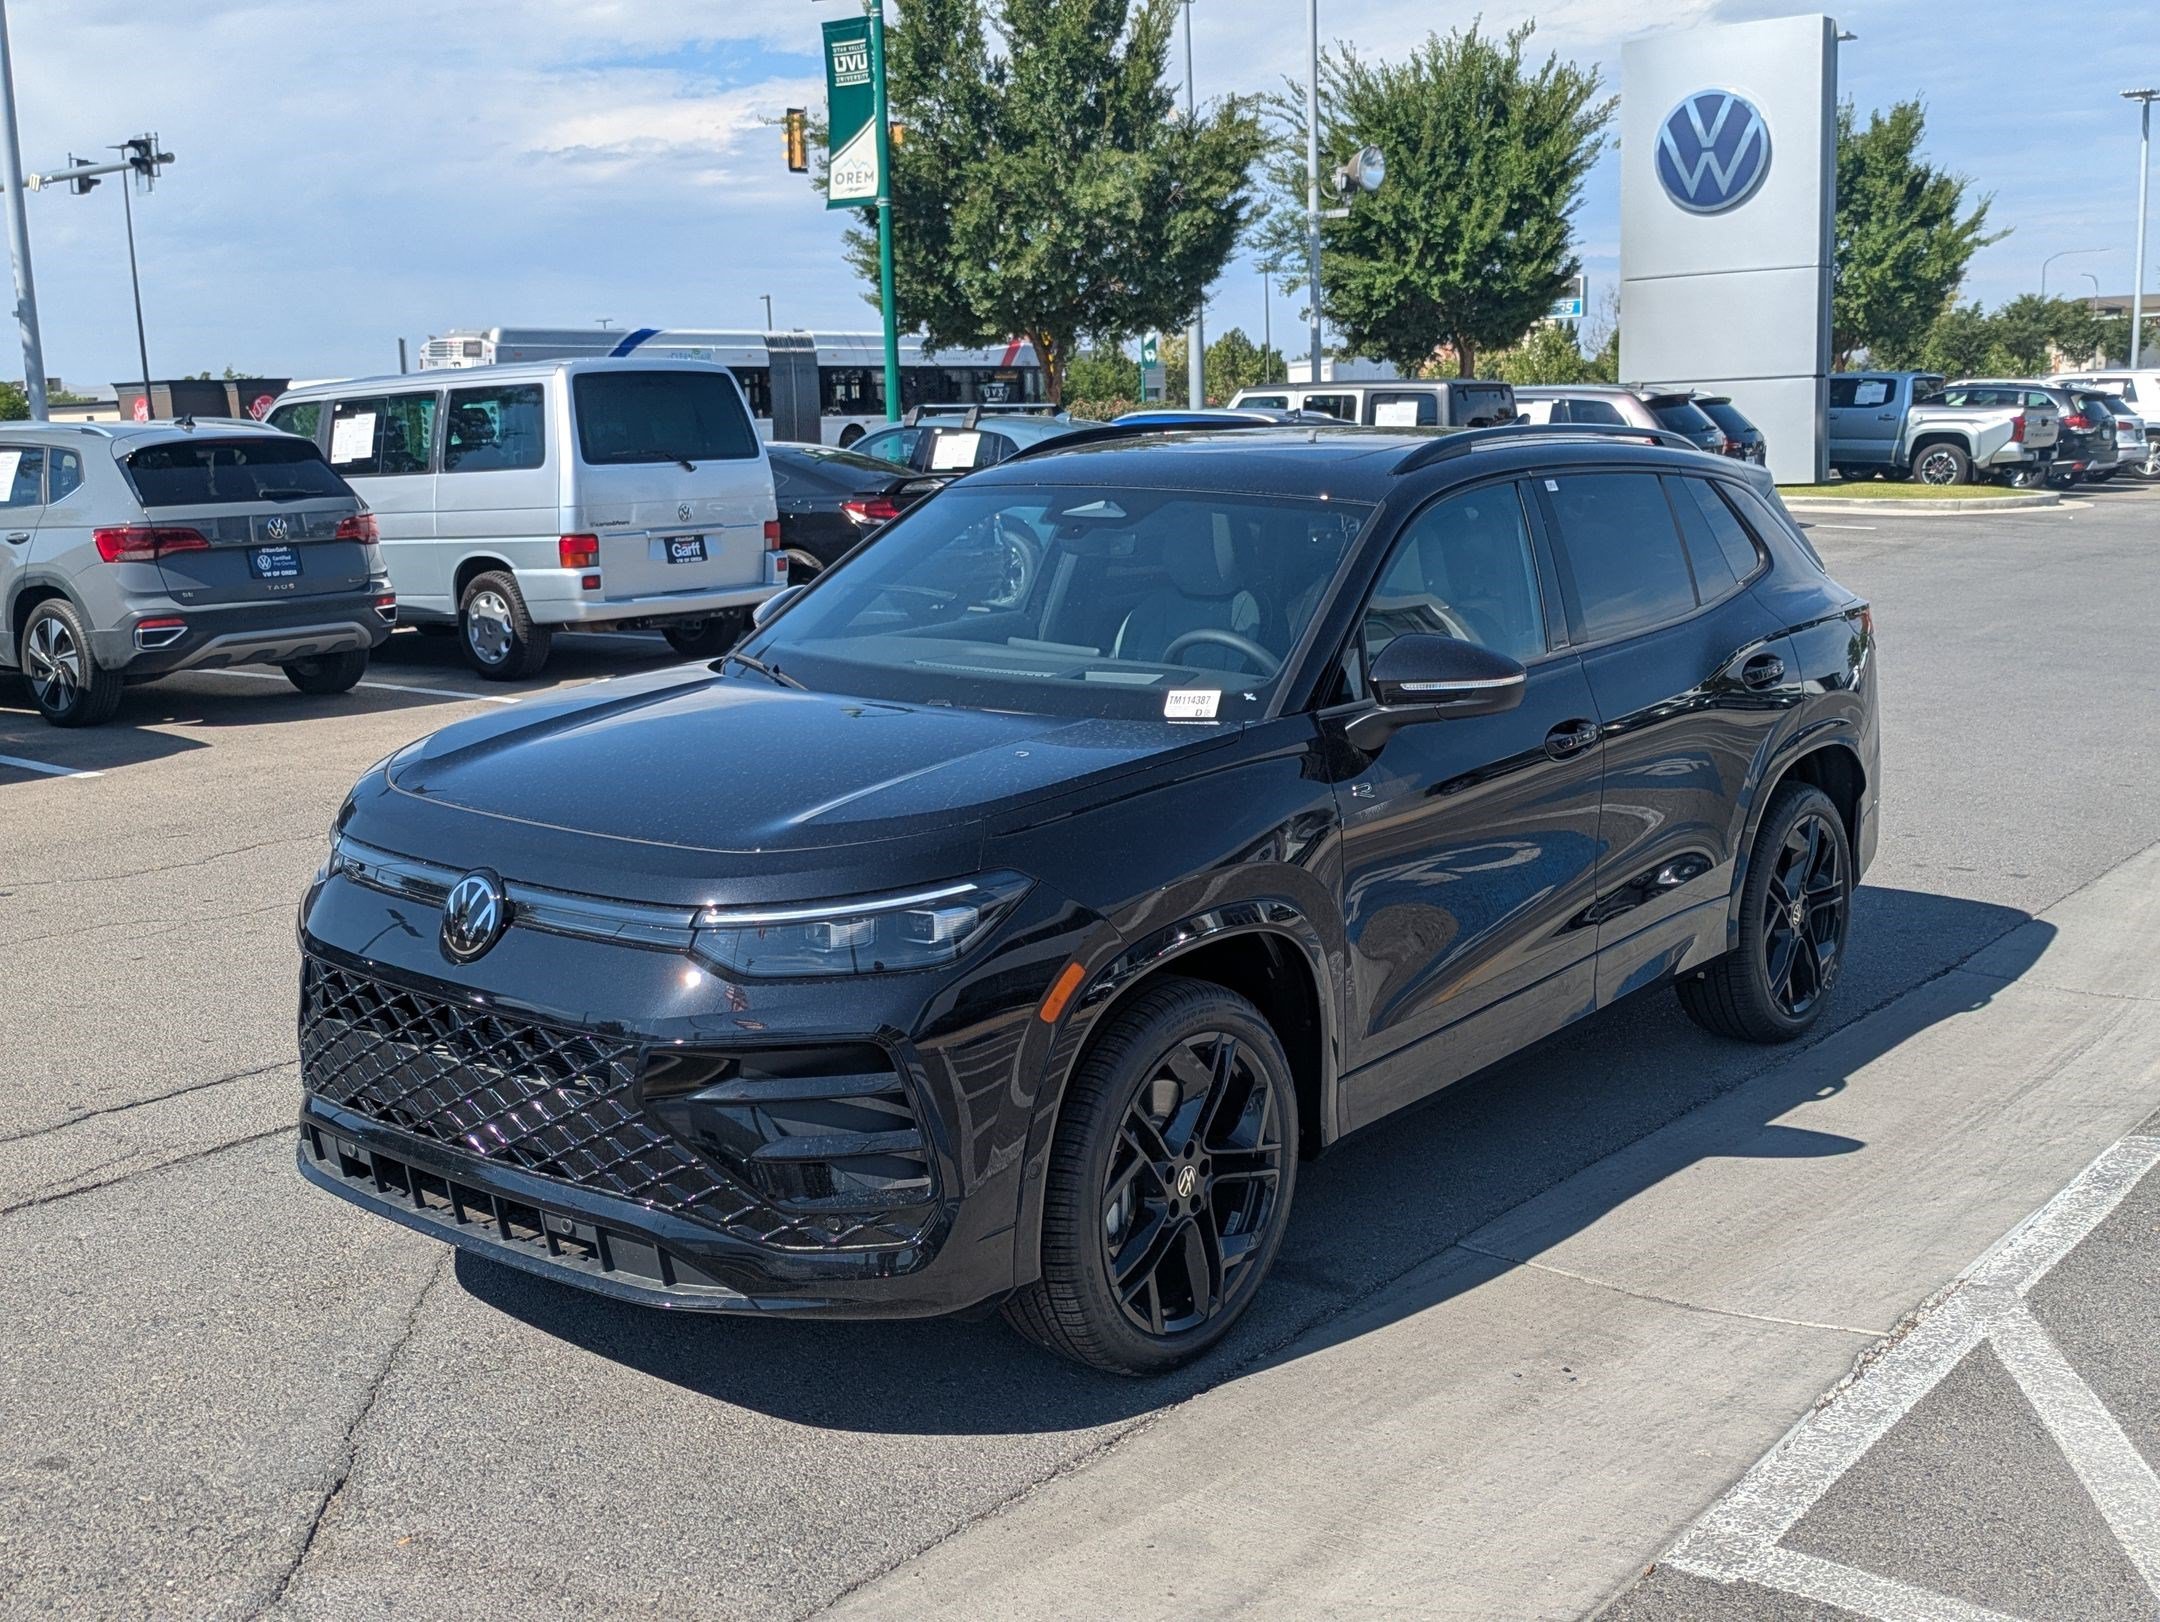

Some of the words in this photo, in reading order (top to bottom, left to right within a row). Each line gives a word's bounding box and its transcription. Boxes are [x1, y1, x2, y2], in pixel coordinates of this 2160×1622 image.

[834, 53, 868, 73] UVU
[834, 170, 875, 186] OREM
[672, 542, 700, 557] Garff
[1169, 695, 1212, 705] TM114387
